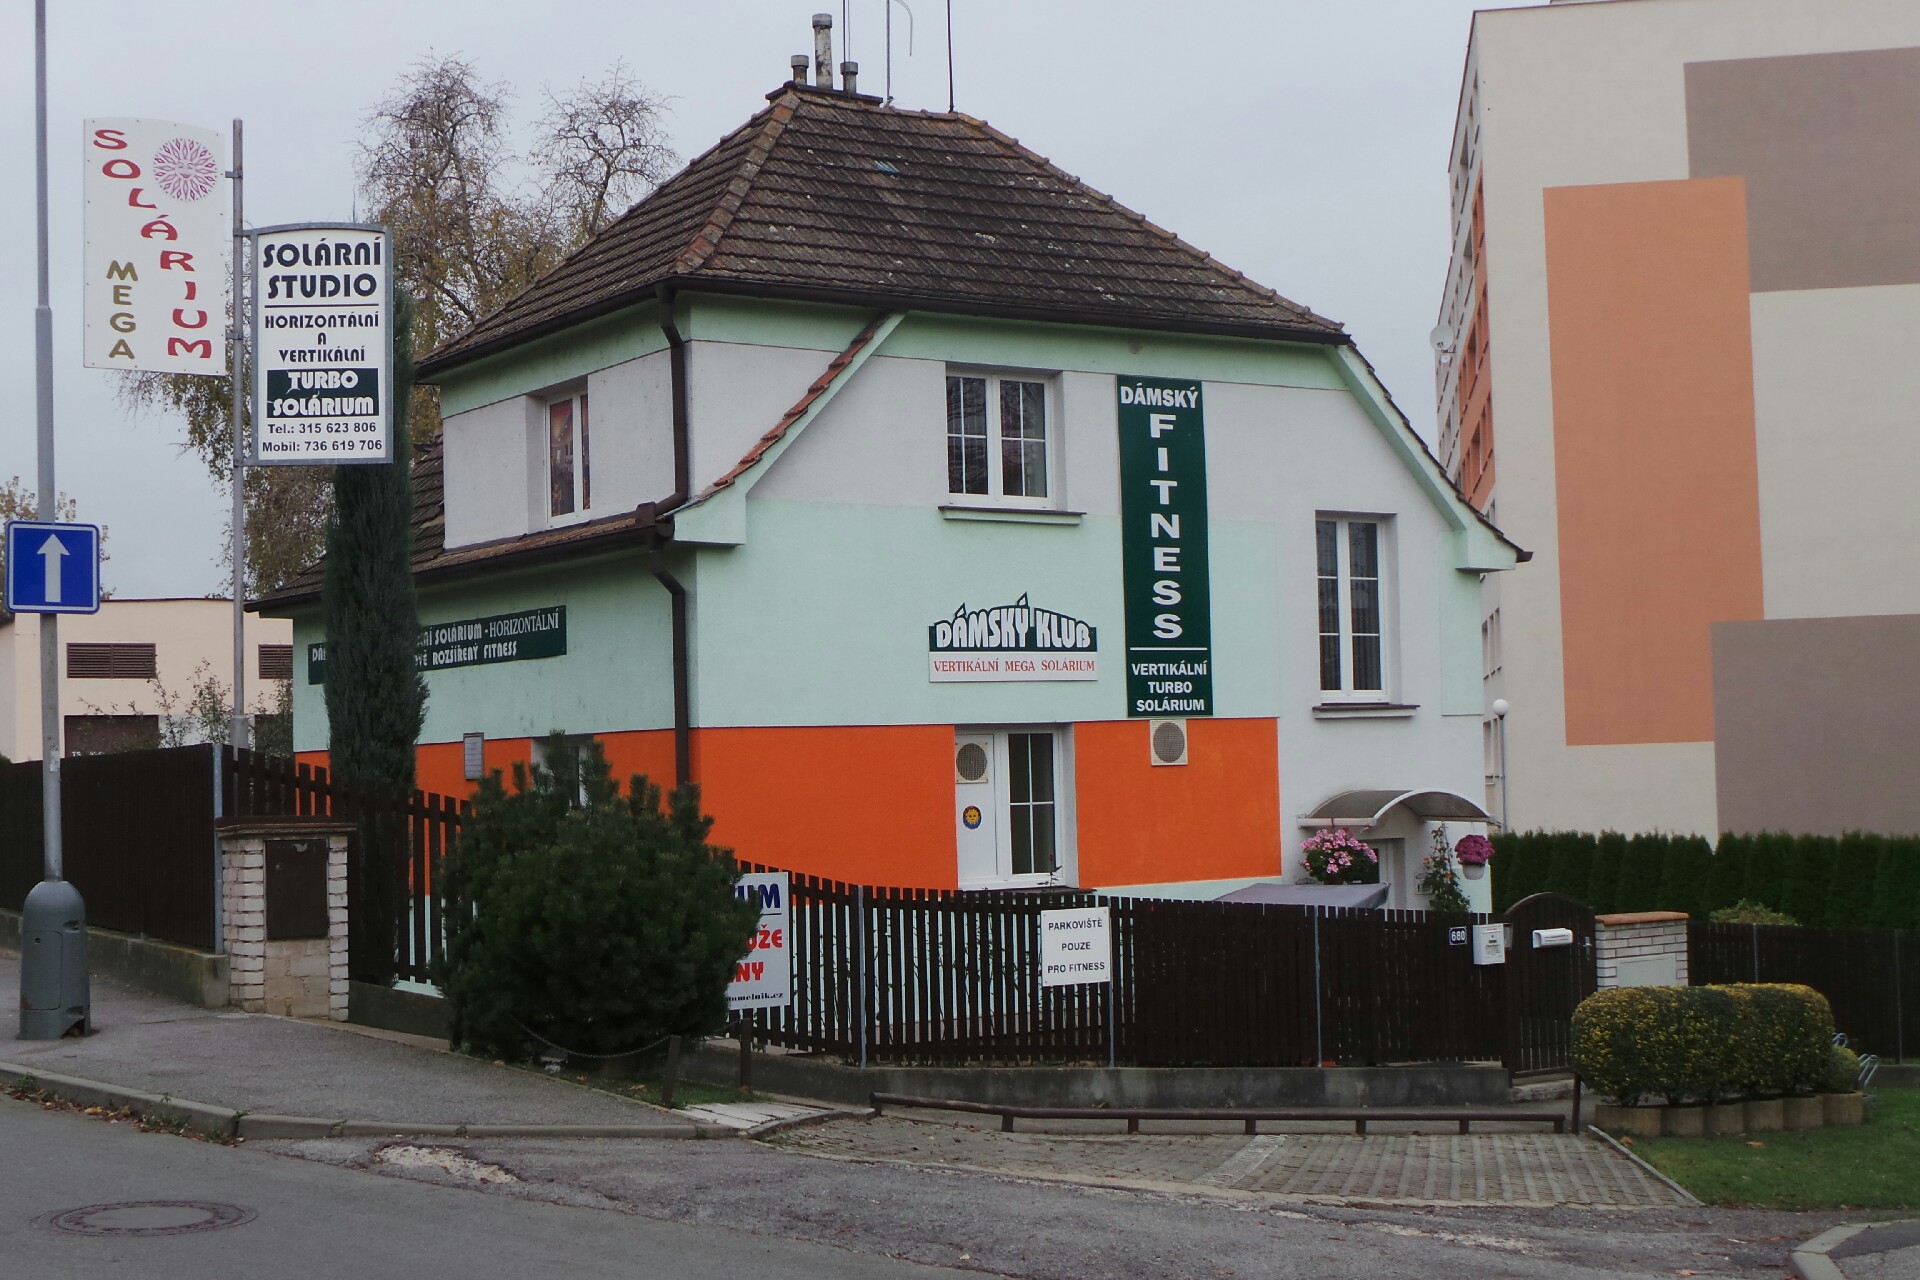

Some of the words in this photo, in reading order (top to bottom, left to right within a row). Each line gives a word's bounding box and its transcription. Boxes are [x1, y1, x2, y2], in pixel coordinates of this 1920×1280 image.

[93, 129, 212, 359] SOLÁRIUM
[263, 236, 381, 268] SOLÁRNÍ
[268, 273, 377, 299] STUDIO
[106, 260, 138, 360] MEGA
[265, 311, 379, 328] HORIZONTÁLNÍ
[317, 332, 327, 345] A
[279, 345, 365, 363] VERTIKÁLNÍ
[286, 370, 358, 391] TURBO
[272, 392, 374, 416] SOLÁRIUM
[1120, 383, 1198, 408] DÁMSKÝ
[268, 423, 294, 434] Tel.:
[299, 423, 321, 434] 315
[326, 422, 349, 433] 623
[353, 422, 376, 433] 806
[262, 441, 300, 452] Mobil:
[305, 441, 327, 451] 736
[332, 440, 355, 451] 619
[359, 440, 382, 450] 706
[1150, 413, 1183, 639] FITNESS
[935, 592, 1030, 648] DÁMSKÝ
[1033, 607, 1091, 648] KLUB
[434, 622, 482, 646] SOLÁRIUM
[483, 641, 517, 659] FITNESS
[934, 658, 999, 672] VERTIKÁLNÍ
[1005, 660, 1035, 672] MEGA
[1041, 657, 1095, 672] SOLÁRIUM
[1132, 660, 1207, 676] VERTIKÁLNÍ
[1148, 681, 1192, 694] TURBO
[1136, 696, 1205, 712] SOLÁRIUM
[1451, 930, 1465, 942] 680
[1061, 942, 1091, 951] POUZE
[734, 961, 764, 982] NY
[1047, 964, 1066, 974] PRO
[1069, 961, 1105, 972] FITNESS
